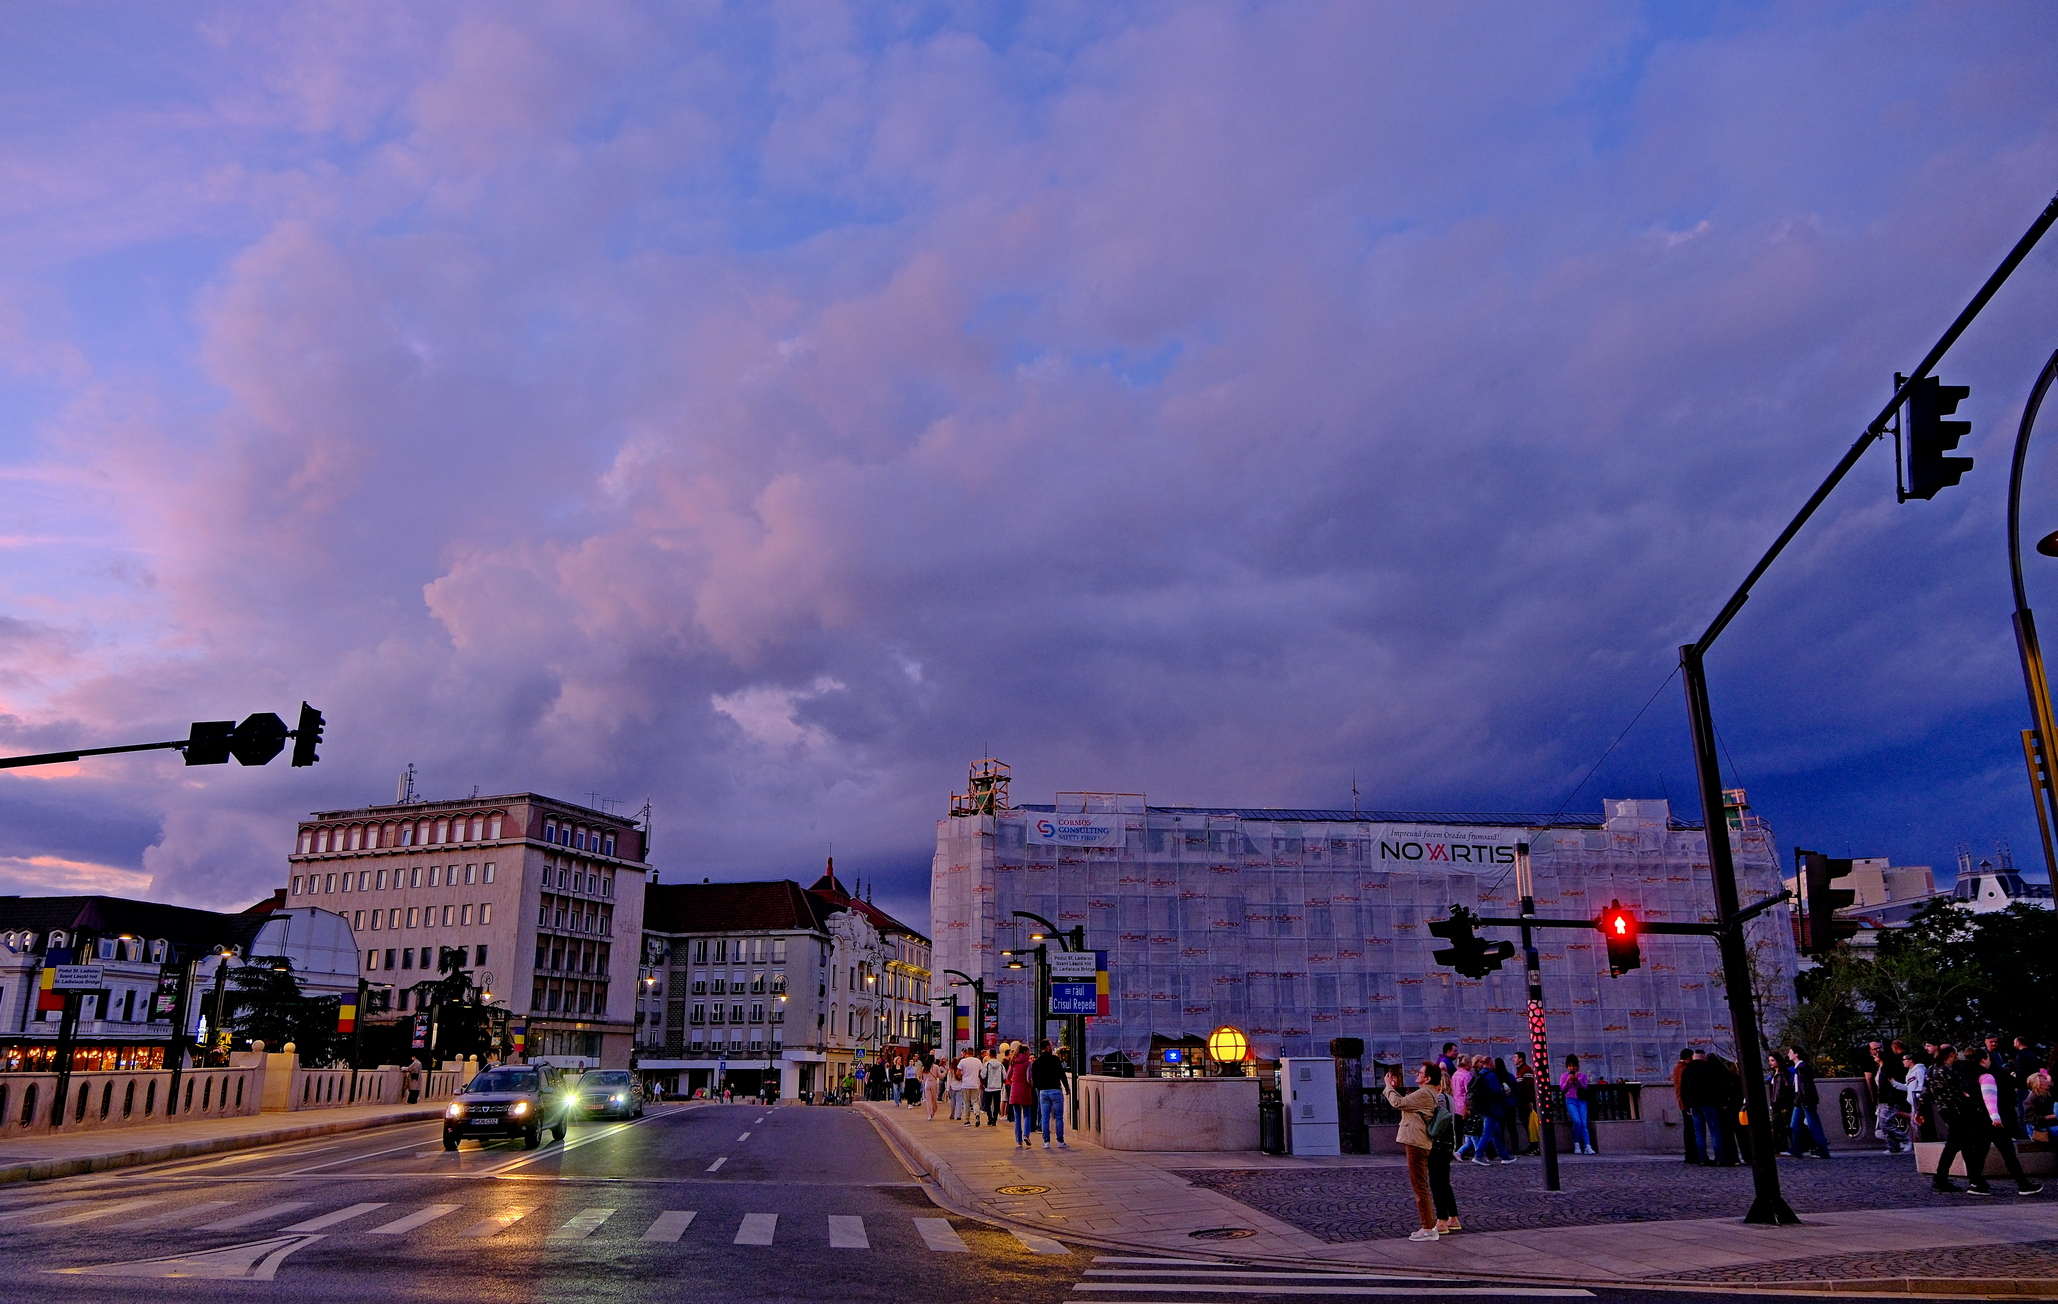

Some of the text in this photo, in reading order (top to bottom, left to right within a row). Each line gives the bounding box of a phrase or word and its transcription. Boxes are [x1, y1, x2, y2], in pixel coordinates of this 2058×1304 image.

[1422, 830, 1442, 839] facem
[1381, 841, 1515, 864] NOVARTIS
[1054, 998, 1096, 1012] Crișul Repede
